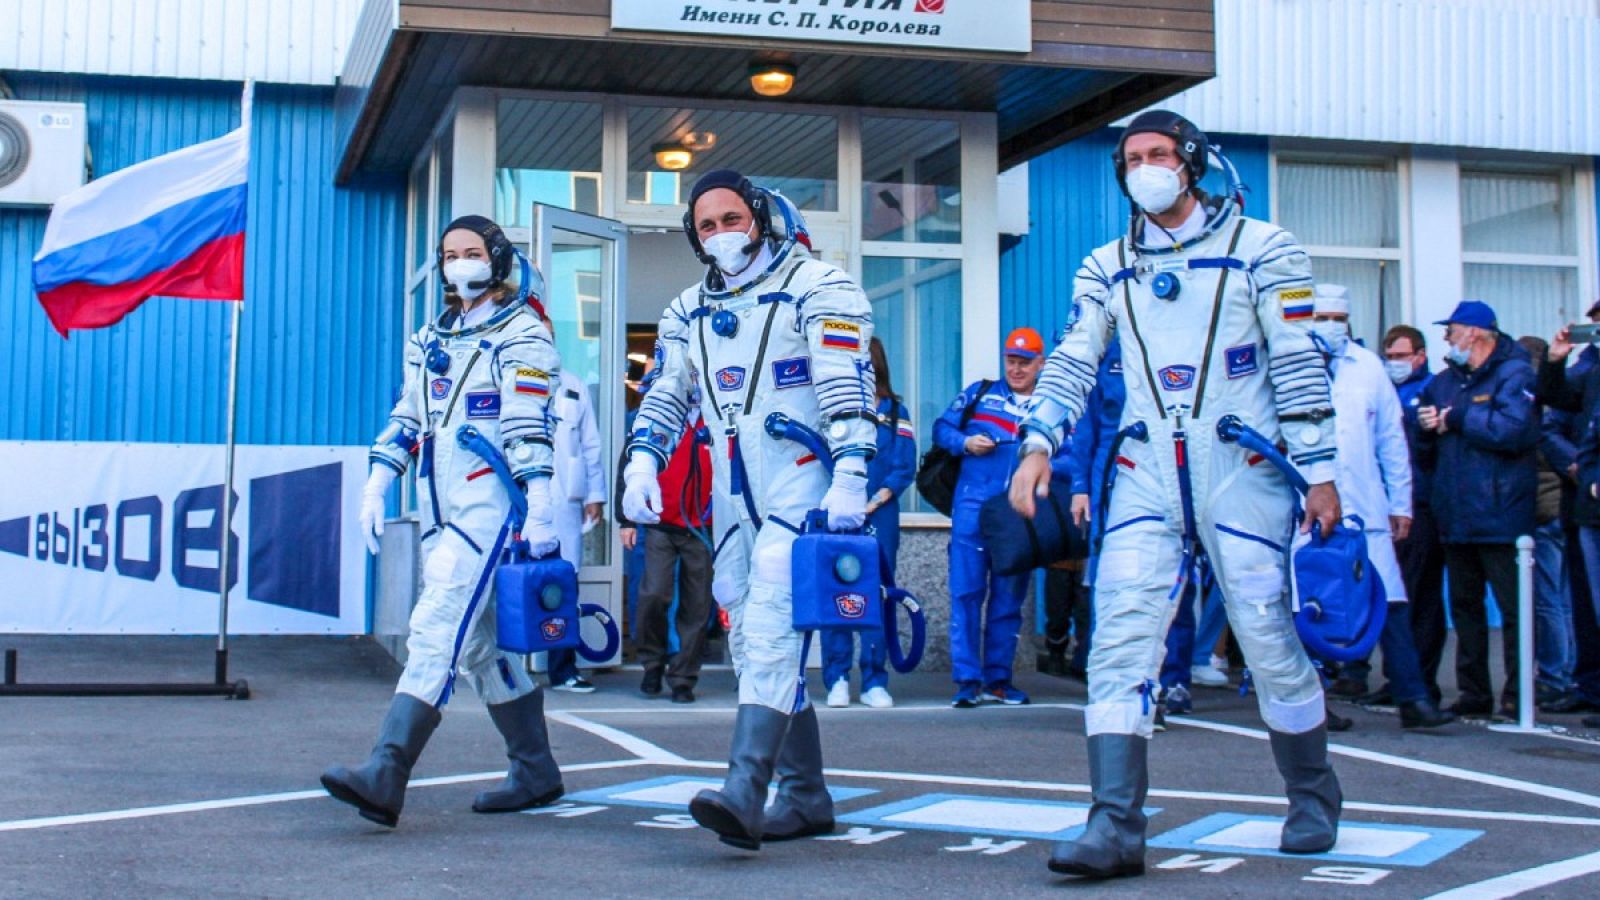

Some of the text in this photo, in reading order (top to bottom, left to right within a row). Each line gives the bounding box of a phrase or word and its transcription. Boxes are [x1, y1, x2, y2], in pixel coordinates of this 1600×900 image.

[680, 5, 761, 25] Имени
[767, 11, 789, 26] С.
[796, 12, 820, 28] П.
[828, 14, 942, 35] Королева
[36, 483, 239, 594] ВЫЗОВ
